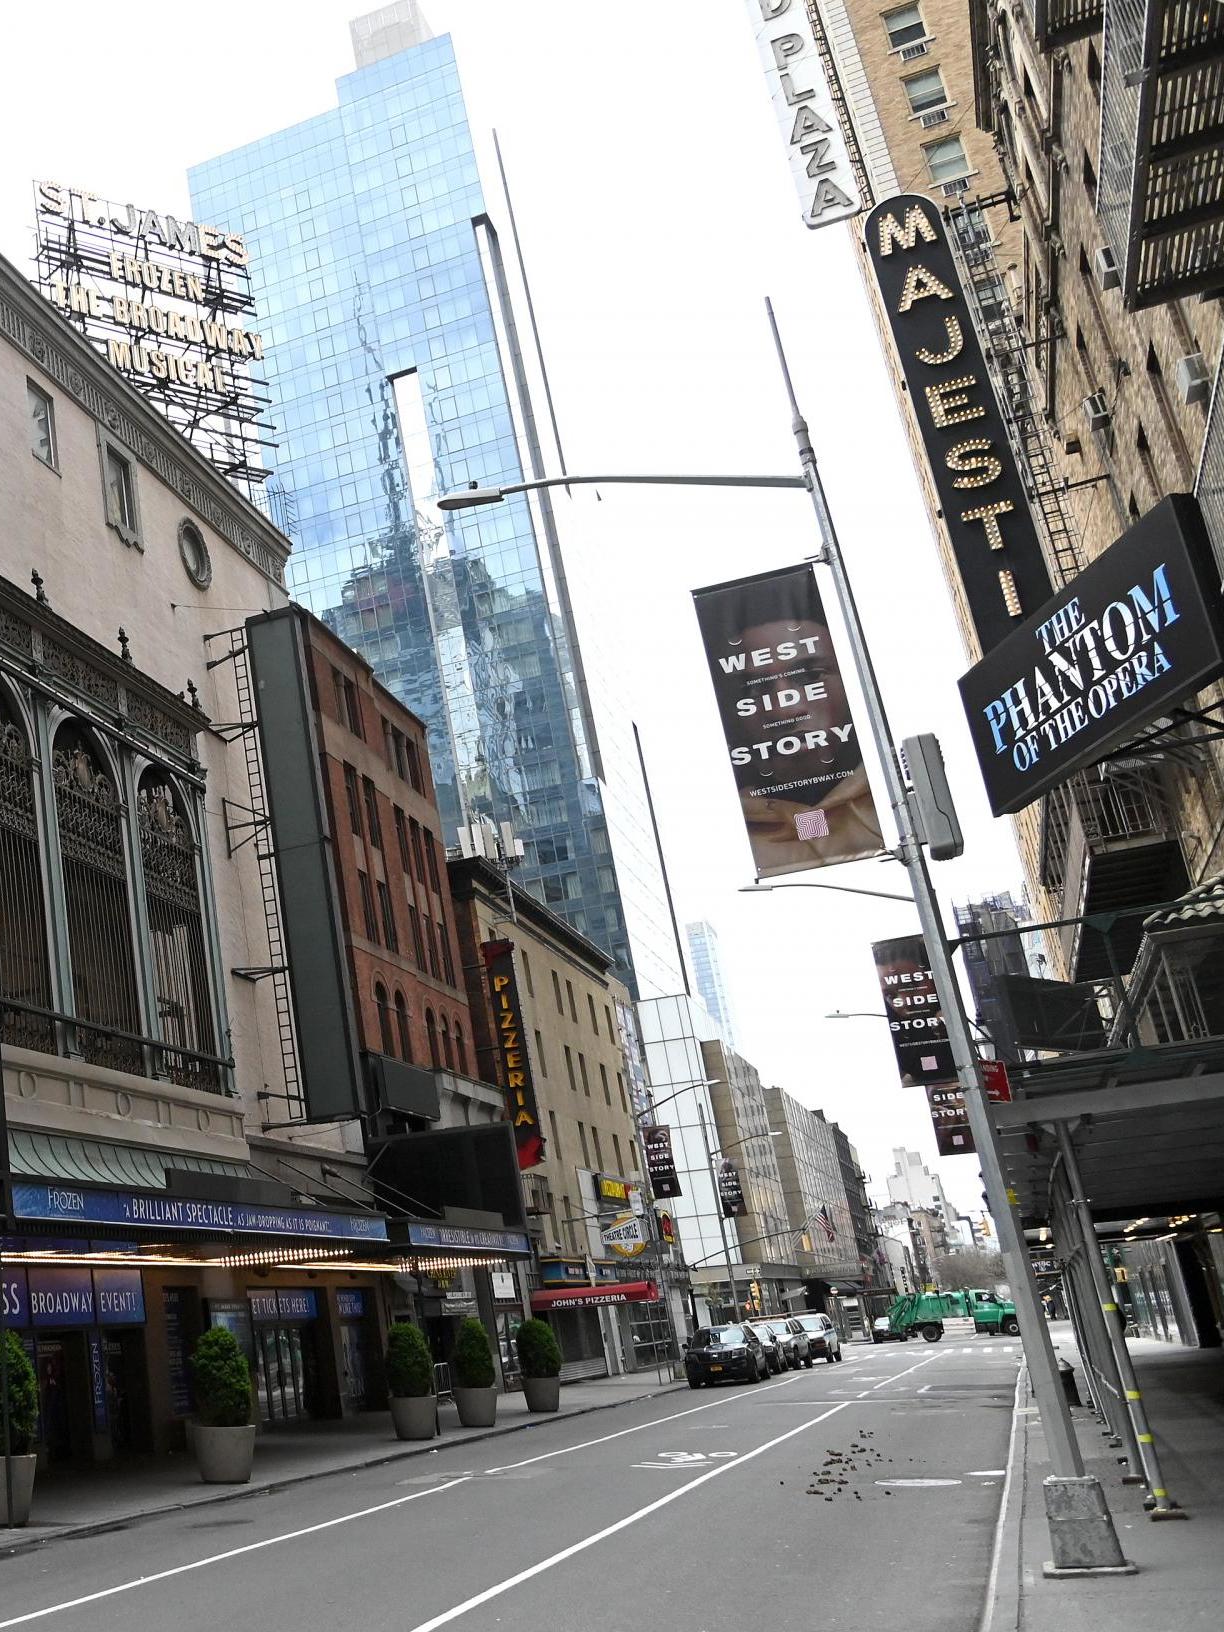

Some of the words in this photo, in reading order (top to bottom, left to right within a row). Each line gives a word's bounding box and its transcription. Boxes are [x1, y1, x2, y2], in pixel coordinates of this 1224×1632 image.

[770, 32, 854, 218] PLAZA
[39, 180, 106, 227] ST.
[111, 203, 250, 268] JAMES
[108, 250, 205, 303] FROZEN
[50, 278, 104, 319] THE
[111, 295, 265, 361] BROADWAY
[106, 339, 228, 394] MUSICAL
[878, 204, 1024, 618] MAJESTI
[1034, 596, 1086, 657] THE
[718, 635, 820, 675] WEST
[982, 562, 1181, 756] PHANTOM
[735, 681, 828, 718] SIDE
[1012, 734, 1046, 773] OF
[1040, 699, 1090, 752] THE
[1087, 640, 1173, 719] OPERA
[762, 717, 795, 730] SOMETHING
[730, 722, 854, 767] STORY
[748, 769, 855, 798] WESTSIDESTORYBWAY.COM
[884, 970, 934, 986] WEST
[892, 993, 939, 1008] SIDE
[493, 974, 534, 1128] PIZZERIA
[933, 1091, 965, 1102] SIDE
[931, 1108, 968, 1119] STOR
[646, 1141, 669, 1149] WEST
[650, 1152, 669, 1161] SIDE
[649, 1164, 675, 1173] STORY
[47, 1186, 85, 1213] FROZEN
[720, 1189, 742, 1197] STORY
[132, 1198, 183, 1223] BRILLIANT
[237, 1216, 245, 1226] AS
[246, 1214, 285, 1229] JAW-DROPPING
[286, 1218, 293, 1229] AS
[603, 1228, 623, 1242] THEATRE
[31, 1292, 93, 1314] BROADWAY
[252, 1298, 261, 1314] ET
[262, 1296, 291, 1314] TICKETS
[551, 1298, 583, 1308] JOHN'S
[585, 1294, 627, 1305] PIZZERIA
[92, 1343, 104, 1405] FROZEN
